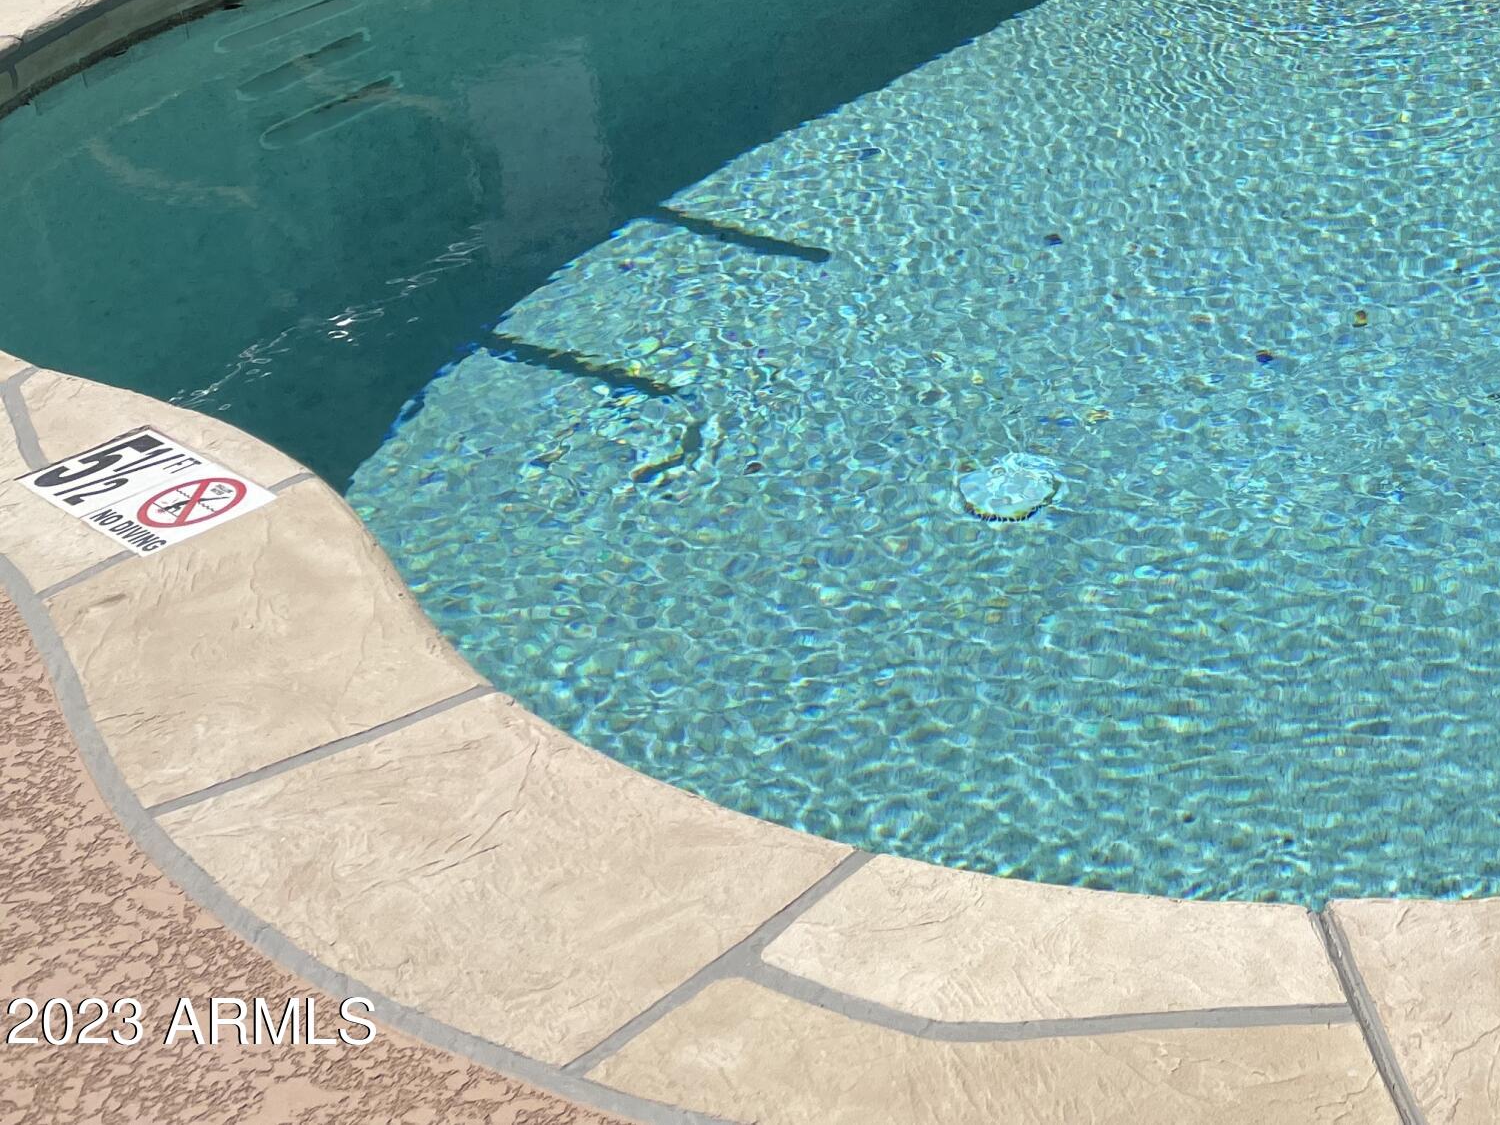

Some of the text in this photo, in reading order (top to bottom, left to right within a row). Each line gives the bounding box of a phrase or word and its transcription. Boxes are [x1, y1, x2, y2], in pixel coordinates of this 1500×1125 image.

[162, 457, 202, 475] FT
[90, 509, 167, 551] NO DIVING
